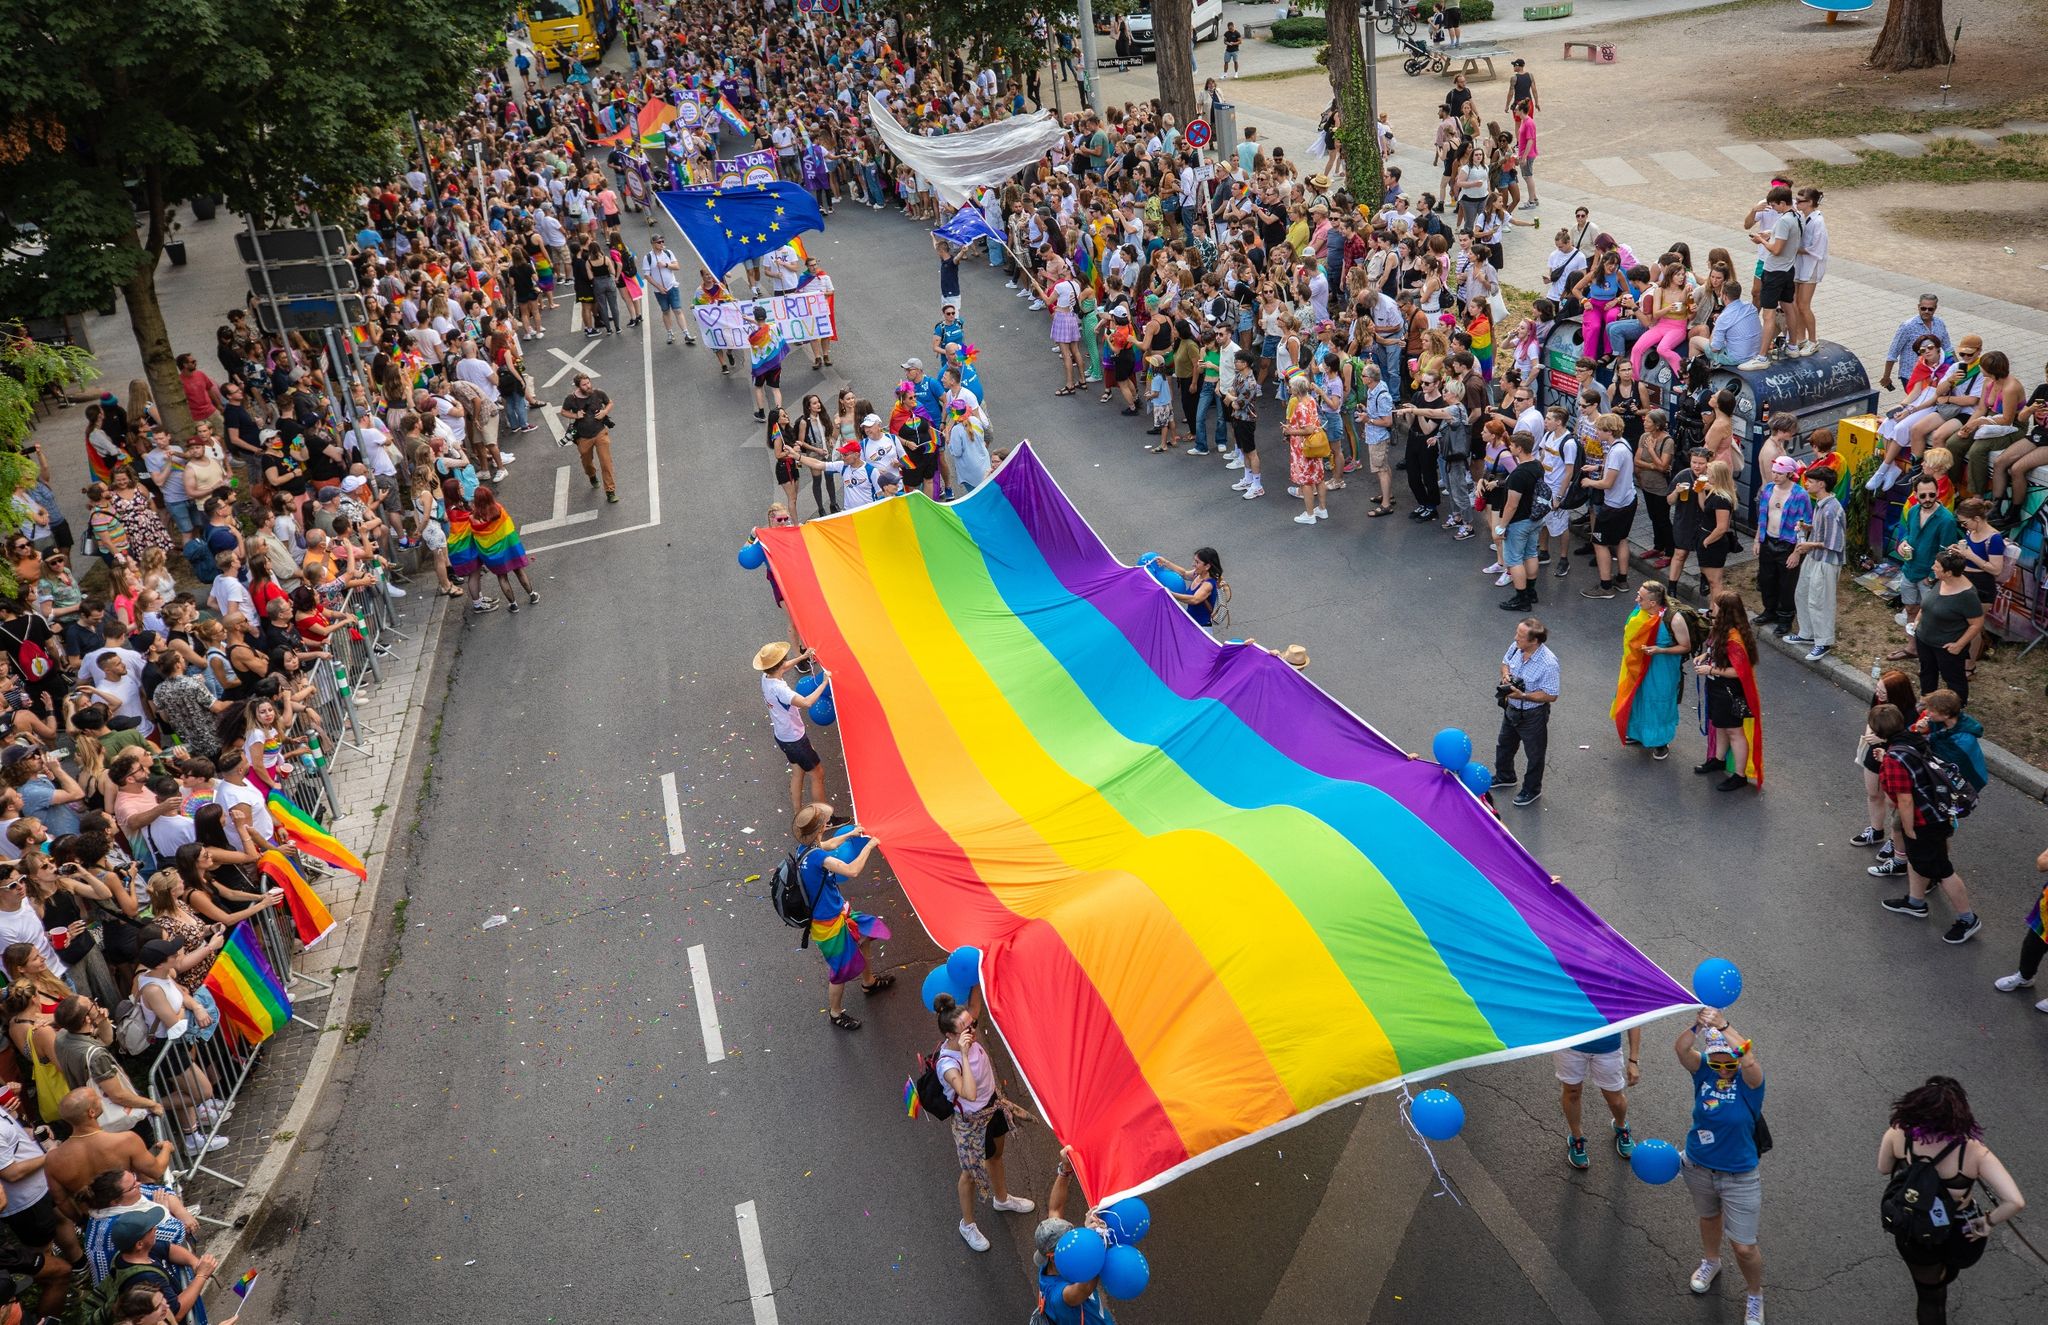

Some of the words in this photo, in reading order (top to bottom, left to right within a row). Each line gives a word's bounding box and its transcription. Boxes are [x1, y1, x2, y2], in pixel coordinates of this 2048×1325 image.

[679, 92, 695, 100] Volt
[743, 153, 767, 168] Volt
[802, 154, 816, 180] Volt
[749, 172, 769, 181] Europe
